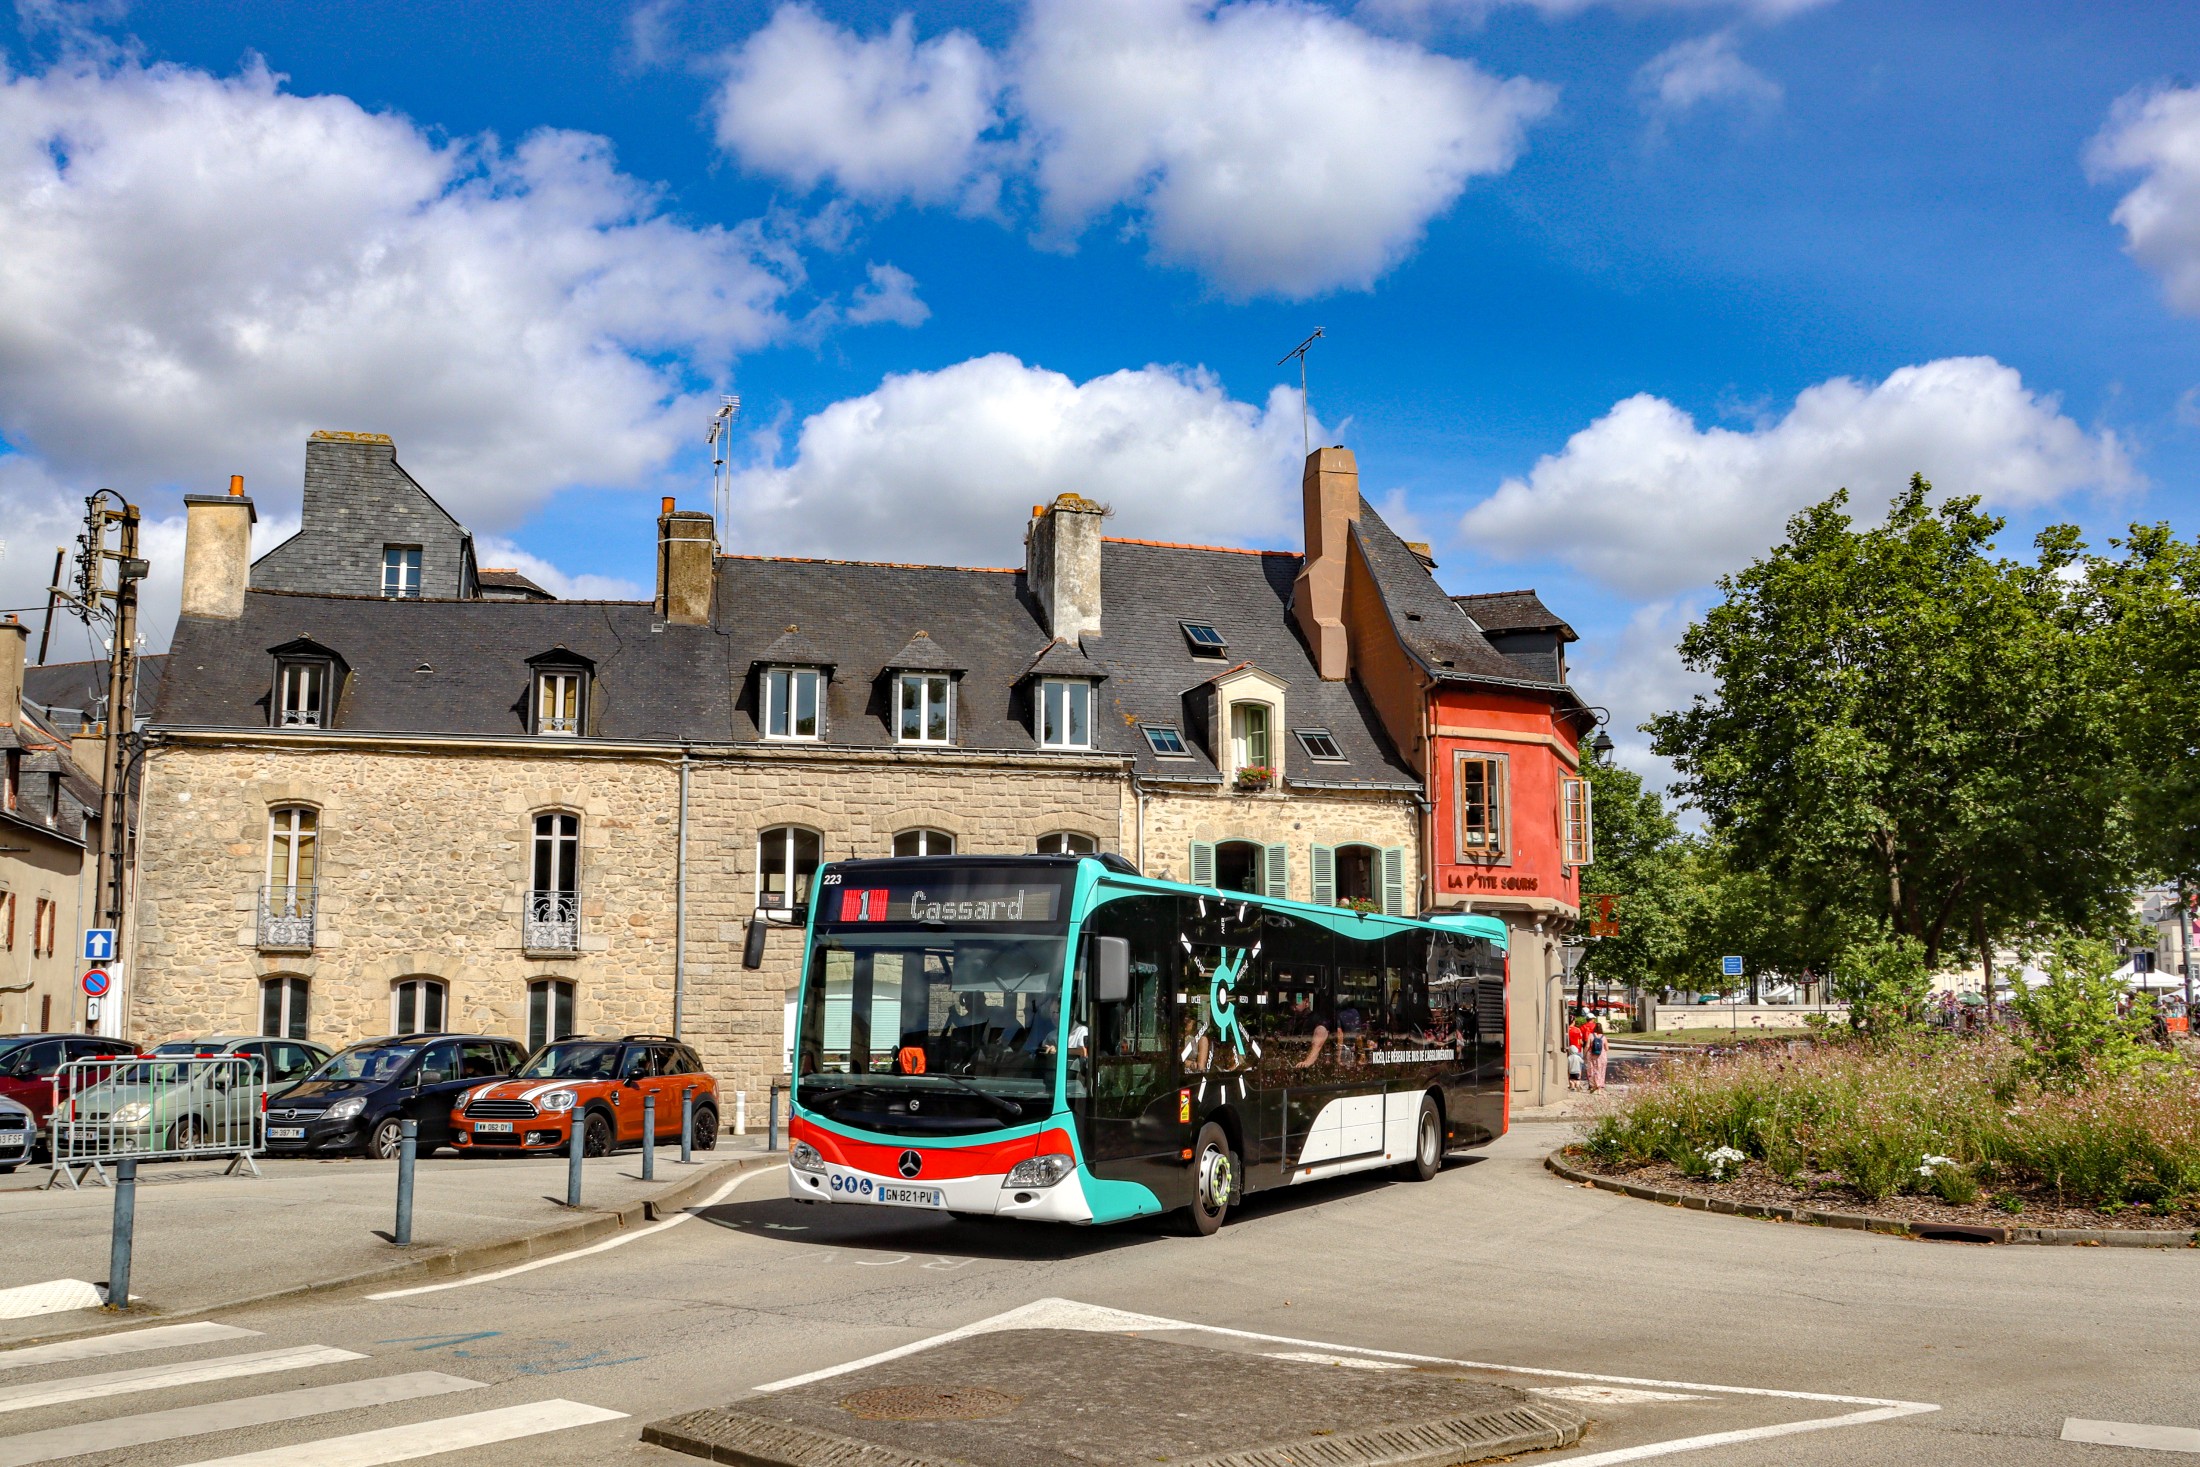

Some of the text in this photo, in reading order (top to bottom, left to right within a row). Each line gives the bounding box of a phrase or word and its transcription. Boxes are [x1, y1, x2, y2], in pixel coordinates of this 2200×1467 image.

[823, 874, 842, 885] 223
[1448, 871, 1538, 891] LA P'TITE SOURIS
[858, 890, 869, 921] 1
[910, 889, 1025, 921] Cassard
[1385, 1051, 1391, 1064] LE
[1390, 1048, 1406, 1063] RÉSEAU
[1405, 1050, 1412, 1063] DE
[1411, 1050, 1420, 1063] BUS
[1419, 1050, 1425, 1062] DE
[1424, 1047, 1455, 1062] L'AGGLOMÉRATION
[886, 1189, 932, 1204] GN-821-PV
